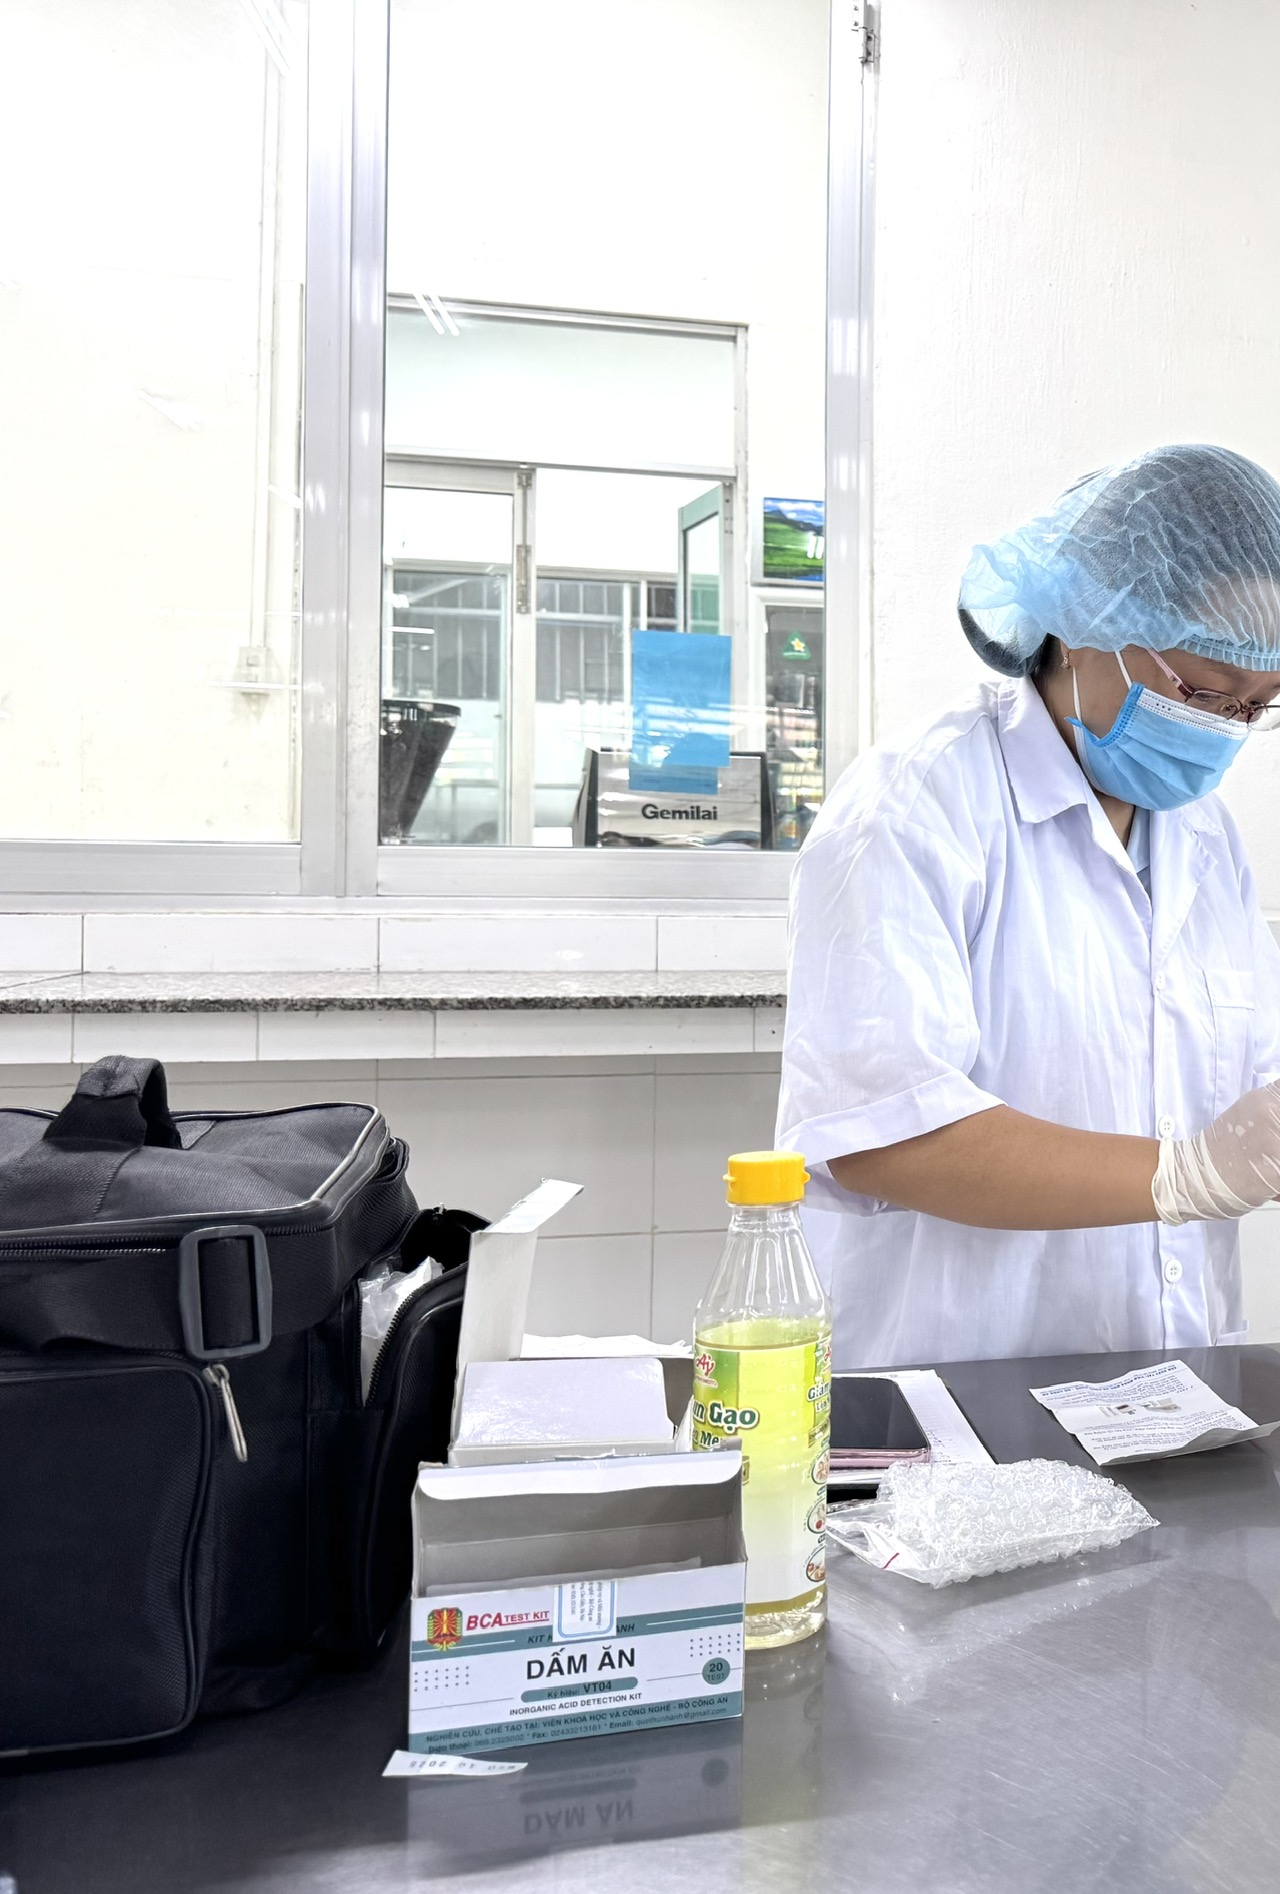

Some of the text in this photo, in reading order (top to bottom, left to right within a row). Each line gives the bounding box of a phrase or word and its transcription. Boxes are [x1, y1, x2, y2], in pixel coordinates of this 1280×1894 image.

[641, 803, 718, 820] Gemilai
[709, 1402, 756, 1431] Gạo
[466, 1611, 549, 1631] BCA TEST KIT
[527, 1634, 545, 1644] KIT
[526, 1645, 636, 1680] DẤM ĂN
[709, 1662, 723, 1673] 20
[707, 1673, 726, 1681] TEST
[583, 1680, 612, 1694] VT04
[509, 1692, 643, 1716] INORGANIC ACID DETECTION KIT
[563, 1715, 588, 1725] KHOA
[717, 1696, 729, 1704] AN
[609, 1719, 634, 1730] Email:
